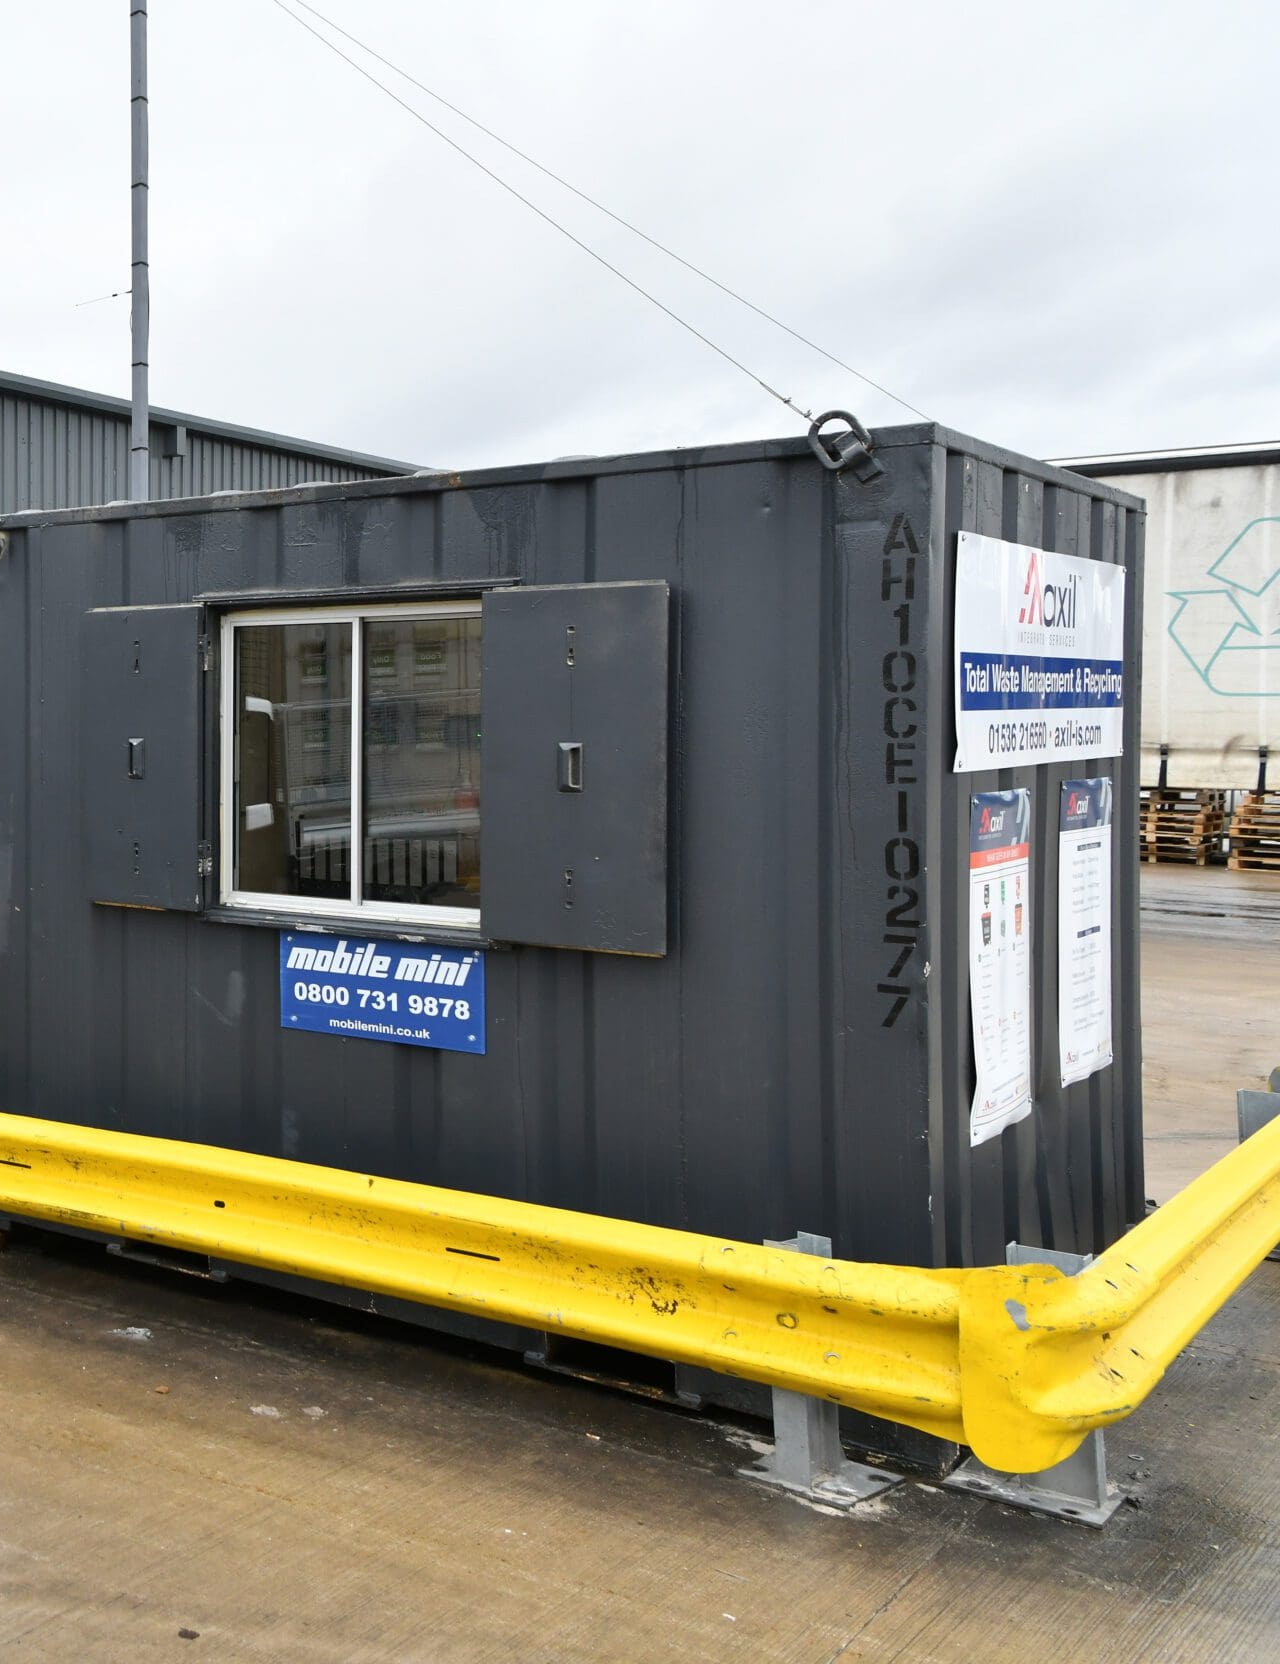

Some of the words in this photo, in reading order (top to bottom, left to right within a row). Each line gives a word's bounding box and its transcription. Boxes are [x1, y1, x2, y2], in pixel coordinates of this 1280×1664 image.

[1044, 574, 1077, 628] axil
[964, 662, 990, 693] Total
[992, 664, 1020, 692] Waste
[1022, 665, 1074, 700] Management
[1075, 668, 1082, 692] &
[1084, 668, 1122, 700] Recycling
[988, 723, 1016, 754] 01536
[1054, 720, 1102, 748] axil-is.com
[286, 940, 391, 978] mobile
[394, 954, 473, 986] mini
[294, 982, 350, 1006] 0800
[356, 988, 398, 1012] 731
[408, 994, 470, 1020] 9878
[329, 1018, 430, 1040] mobilemini.co.uk
